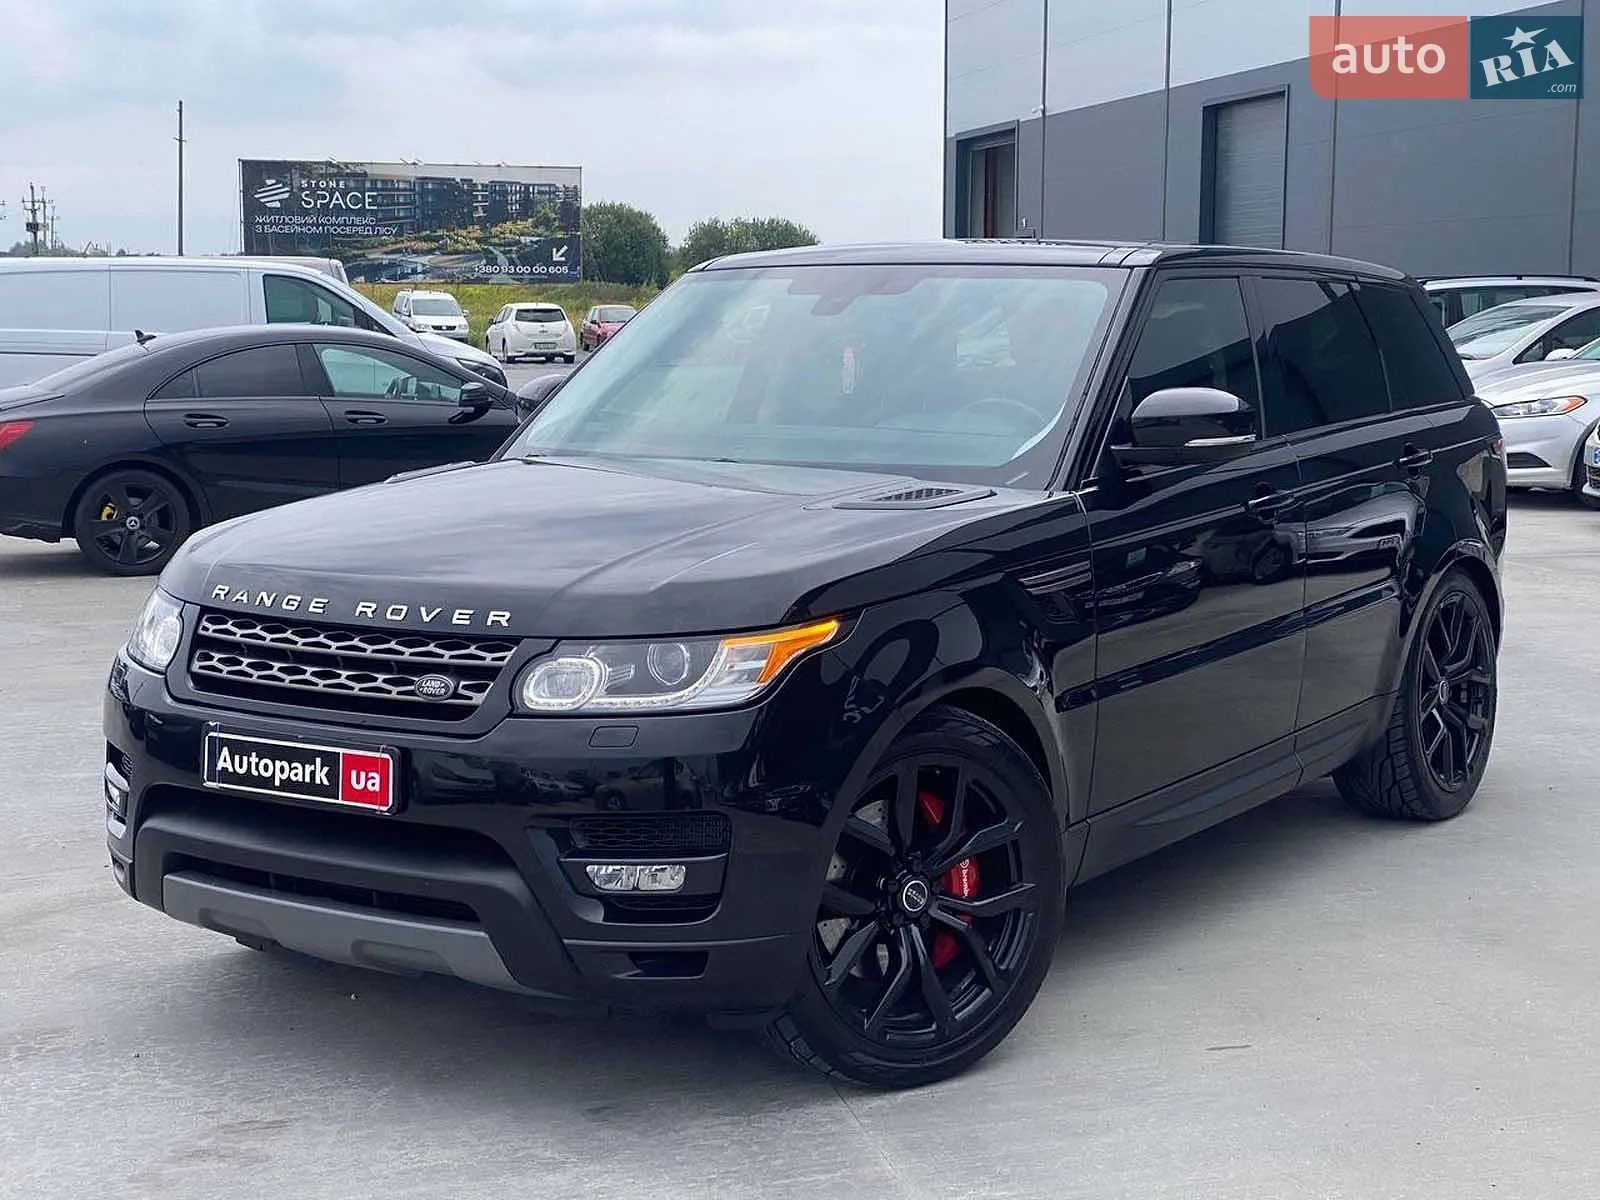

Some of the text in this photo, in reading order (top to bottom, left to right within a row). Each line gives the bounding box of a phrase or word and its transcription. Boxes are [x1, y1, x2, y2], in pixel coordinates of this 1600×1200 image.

[301, 180, 346, 189] STONE
[301, 191, 378, 210] SPACE
[254, 215, 376, 225] ЖИТЛОВИЙ КОМПЛЕКС
[264, 225, 322, 234] БАСЕЙНОМ
[324, 226, 373, 235] ПОСЕРЕД
[516, 265, 531, 273] 00
[532, 265, 547, 273] 00
[211, 584, 512, 627] RANGE ROVER
[216, 746, 380, 792] Autopark ua
